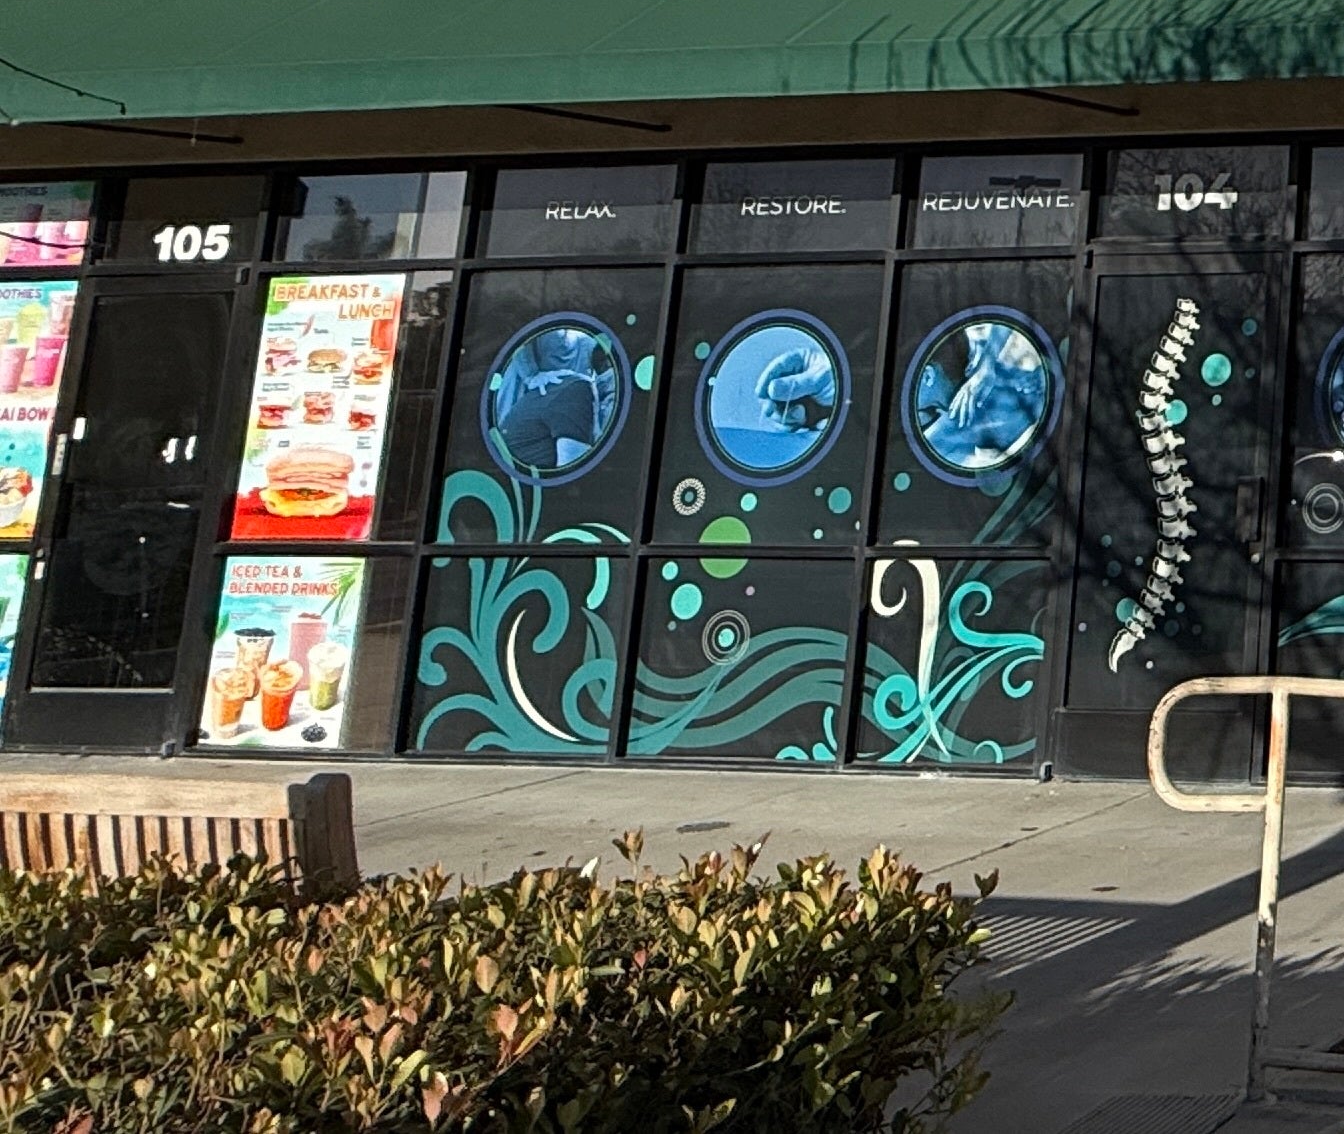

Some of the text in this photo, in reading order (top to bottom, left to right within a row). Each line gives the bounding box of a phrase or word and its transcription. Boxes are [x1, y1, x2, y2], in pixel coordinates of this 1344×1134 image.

[922, 187, 1076, 212] REJUVENATE.
[1153, 172, 1239, 212] 104
[545, 199, 617, 220] RELAX.
[740, 194, 847, 217] RESTORE.
[153, 224, 231, 262] 105
[274, 283, 382, 300] BREAKFAST &
[337, 302, 394, 320] LUNCH
[0, 407, 51, 421] AI BOW
[231, 565, 261, 578] ICED
[265, 565, 289, 578] TEA
[229, 582, 338, 595] BLENDED DRINKS
